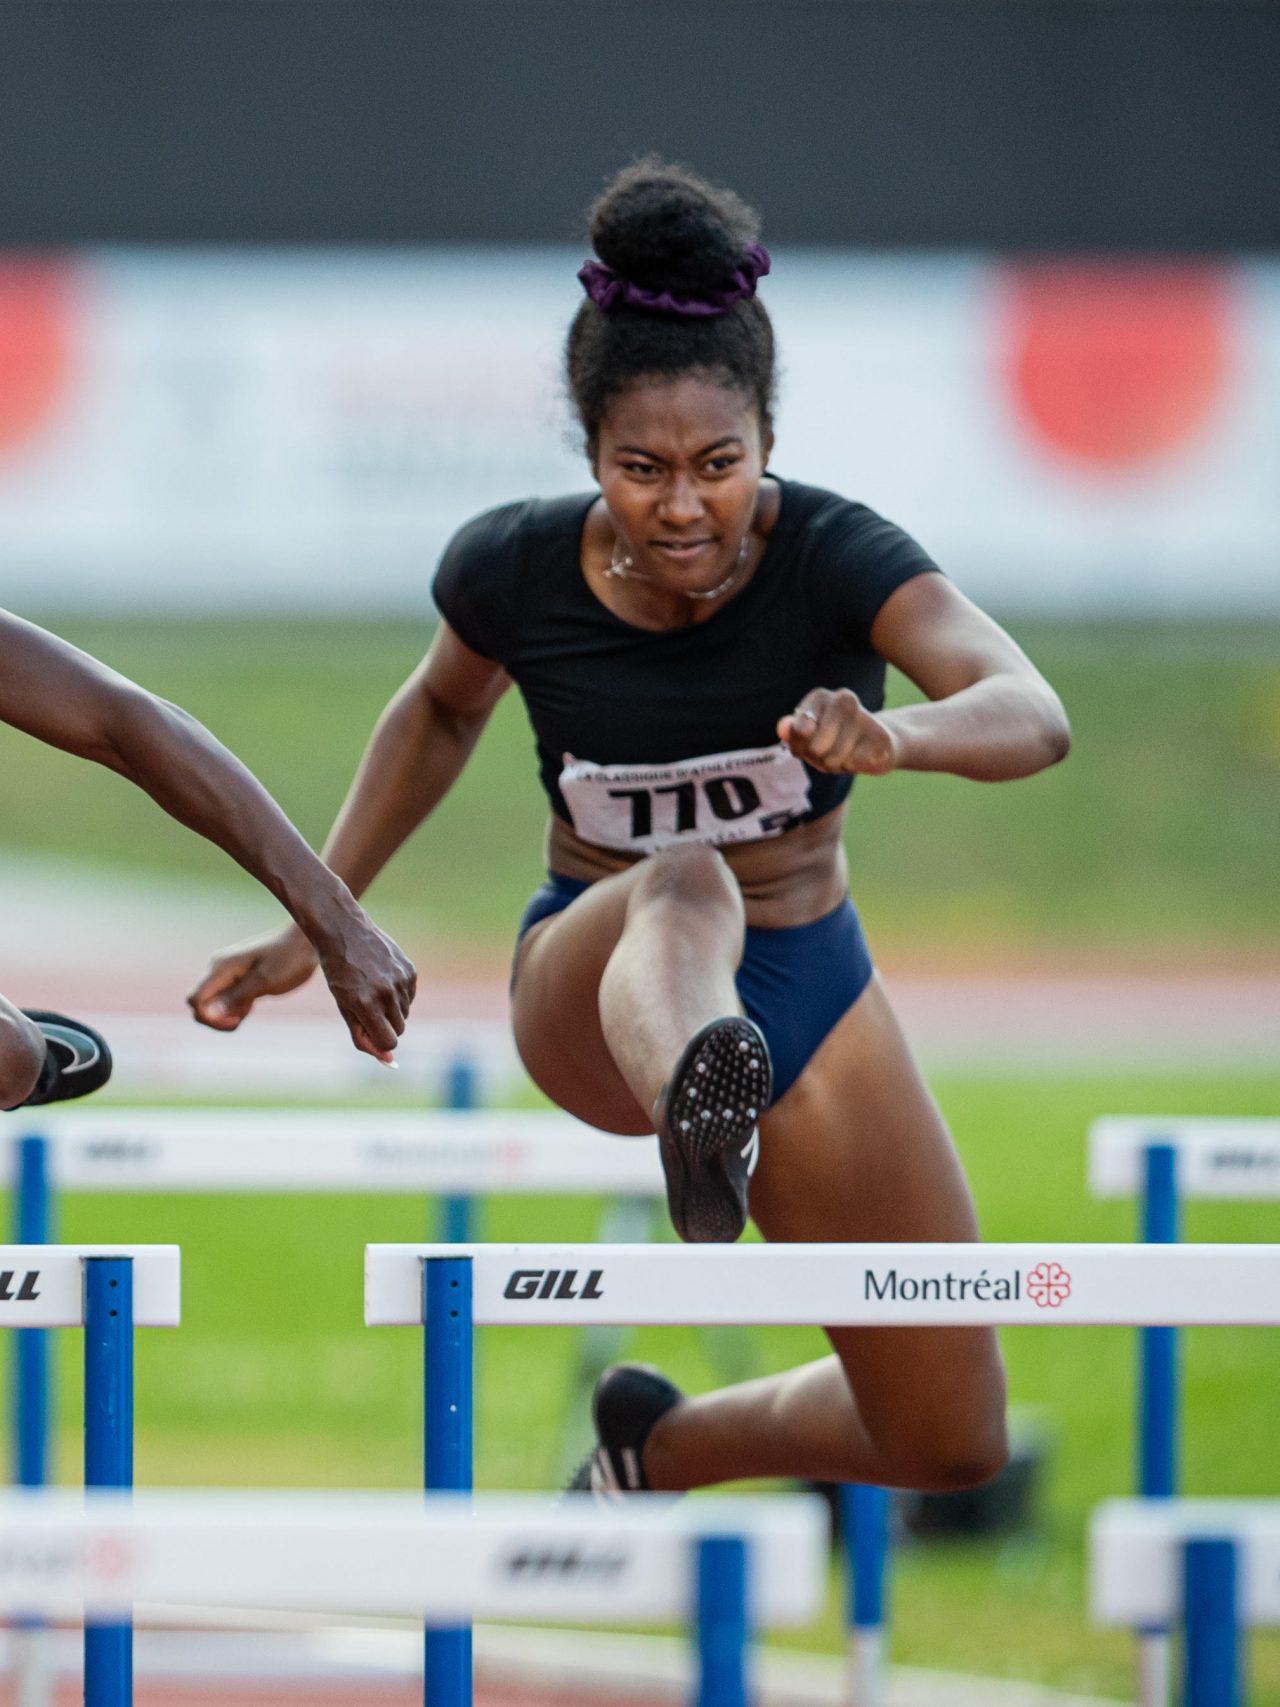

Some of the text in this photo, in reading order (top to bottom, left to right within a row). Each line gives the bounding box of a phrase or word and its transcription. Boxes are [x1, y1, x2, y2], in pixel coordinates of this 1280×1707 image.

[608, 775, 762, 839] 770
[503, 1269, 604, 1300] GILL
[864, 1269, 1021, 1301] Montréal
